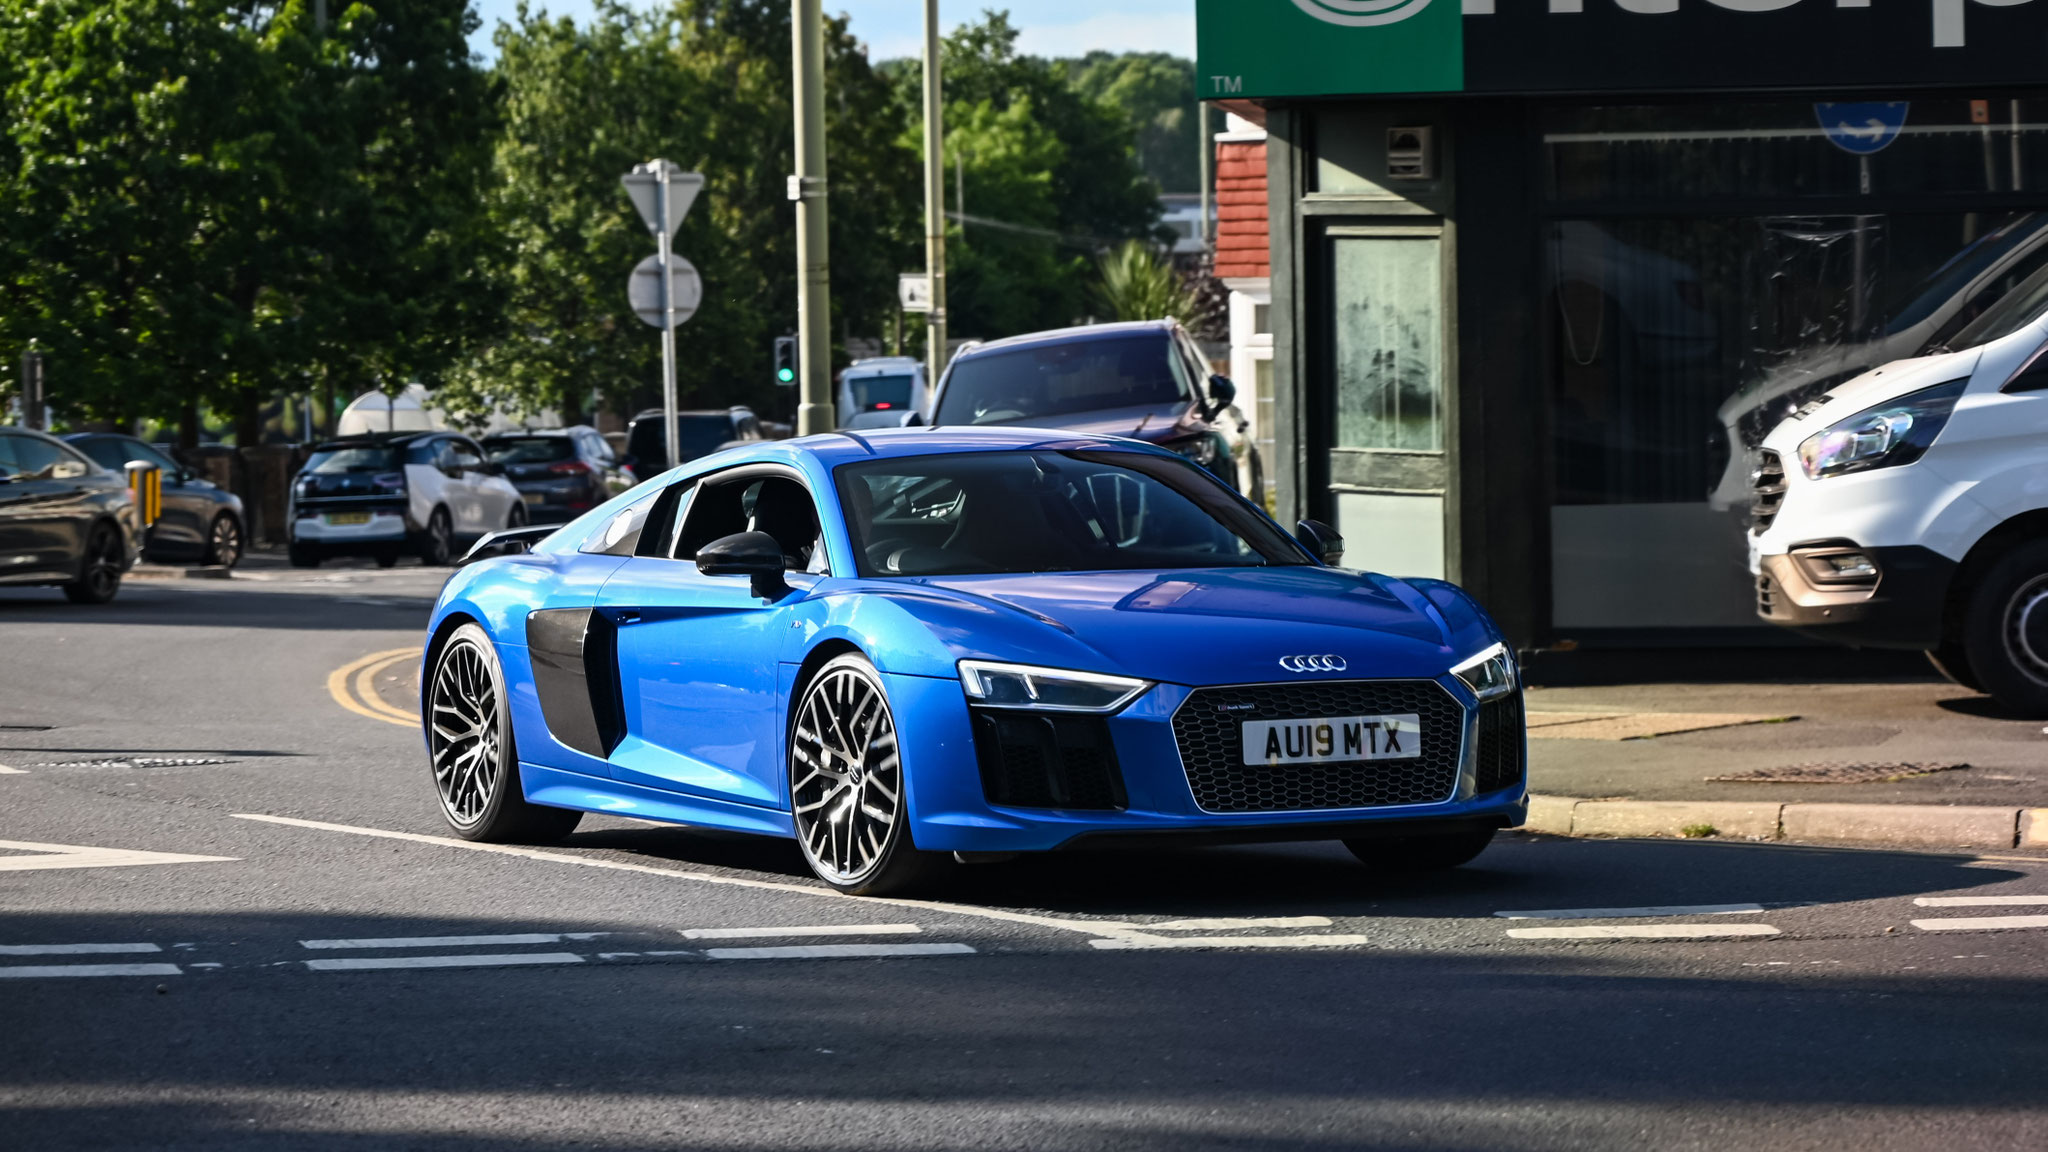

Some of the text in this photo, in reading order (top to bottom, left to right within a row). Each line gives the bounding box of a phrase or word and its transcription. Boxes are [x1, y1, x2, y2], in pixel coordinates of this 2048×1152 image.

[1210, 75, 1242, 93] TM
[1265, 721, 1402, 759] AU19 MTX
